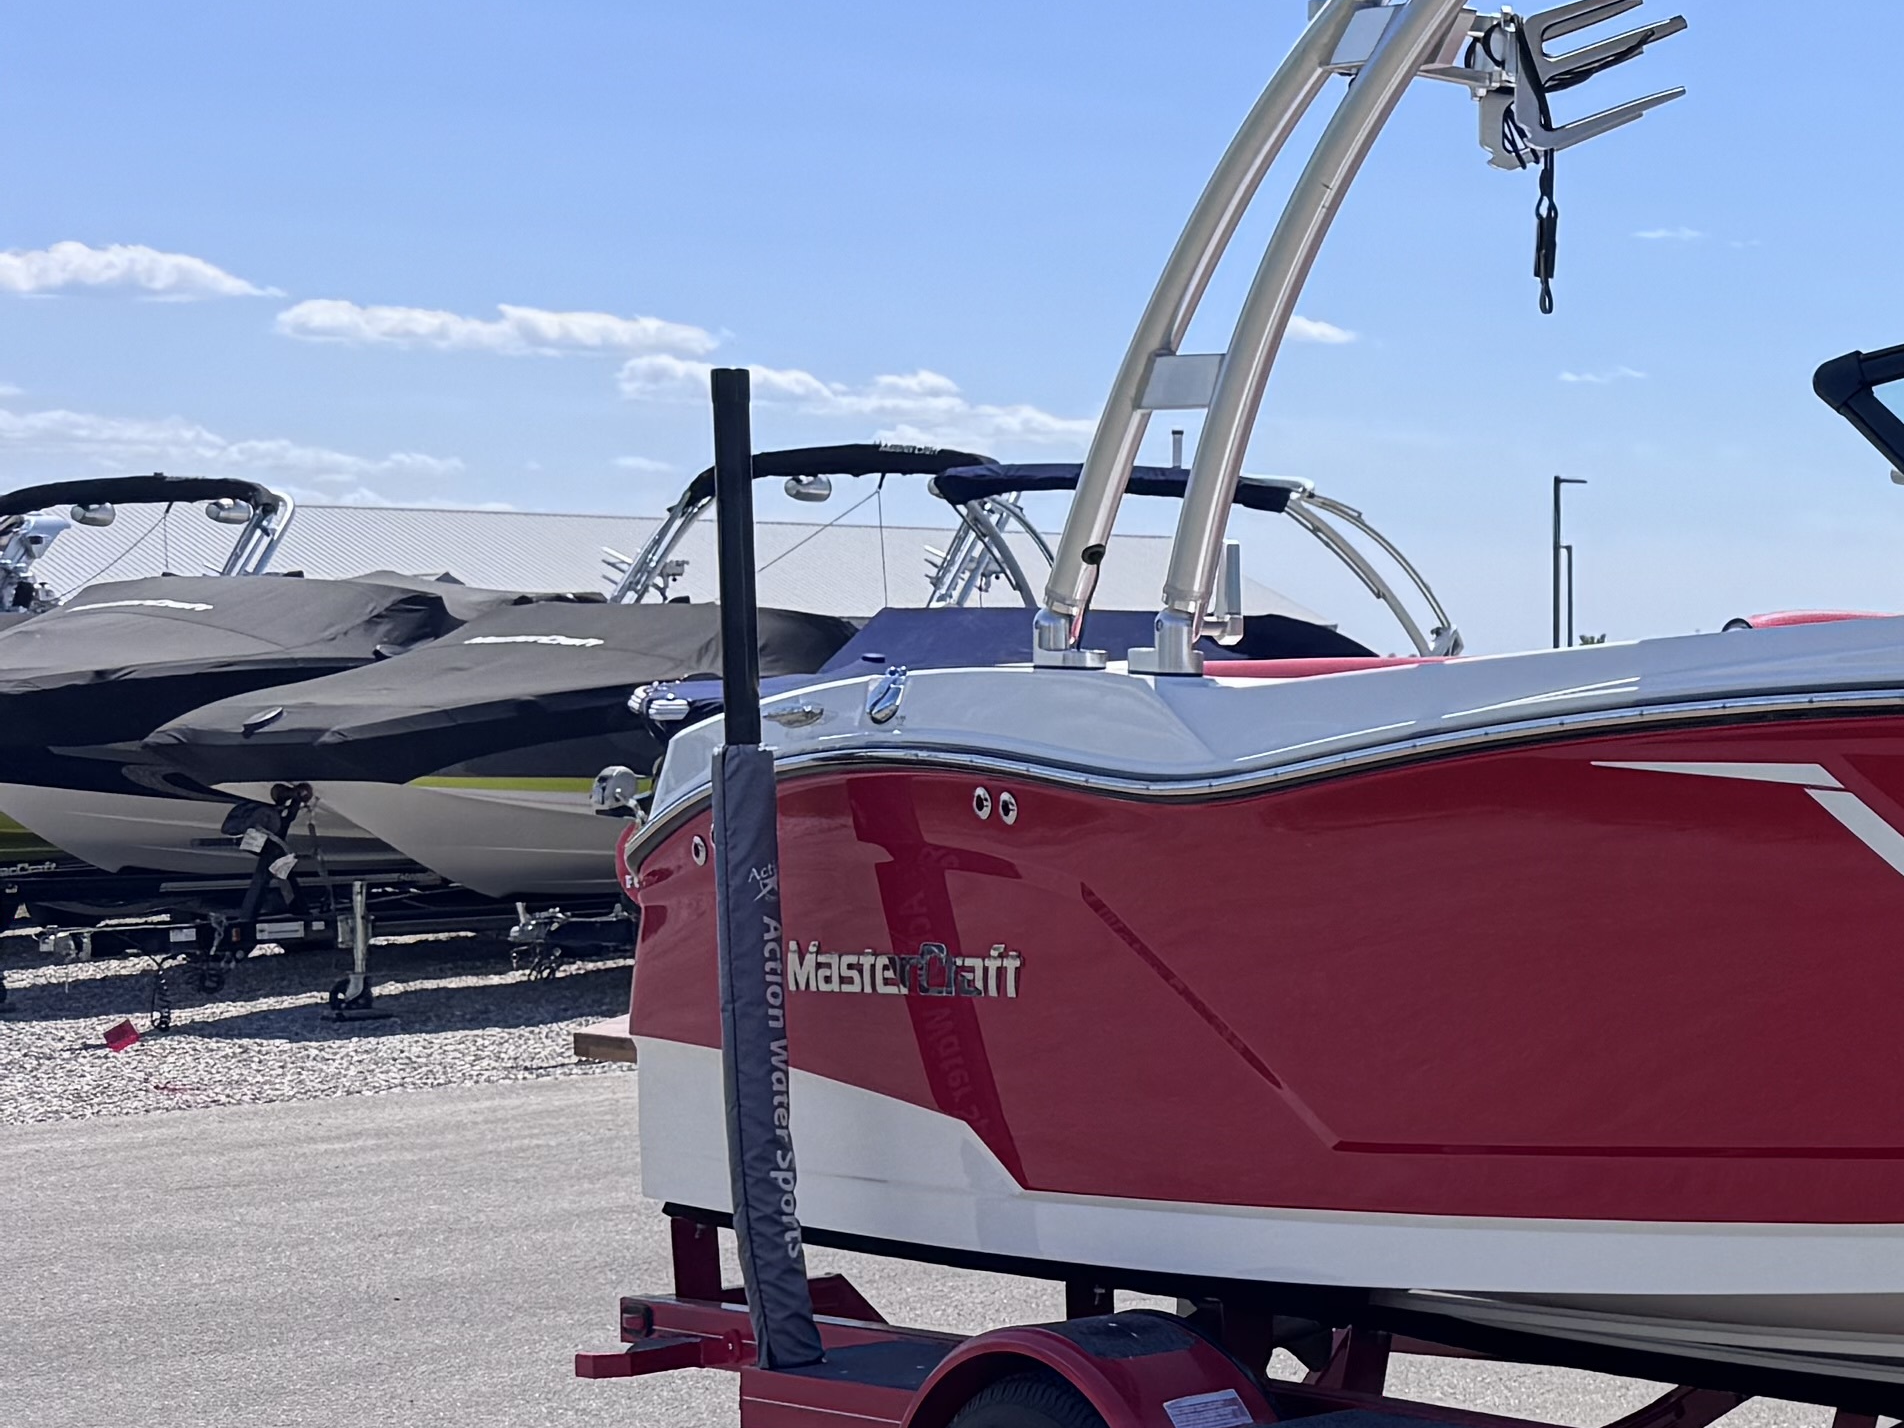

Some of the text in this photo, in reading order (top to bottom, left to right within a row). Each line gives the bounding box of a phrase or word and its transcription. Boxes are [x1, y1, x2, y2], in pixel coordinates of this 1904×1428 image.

[763, 916, 784, 1028] Action
[788, 940, 1022, 998] MasterCraft
[770, 1039, 789, 1144] Water
